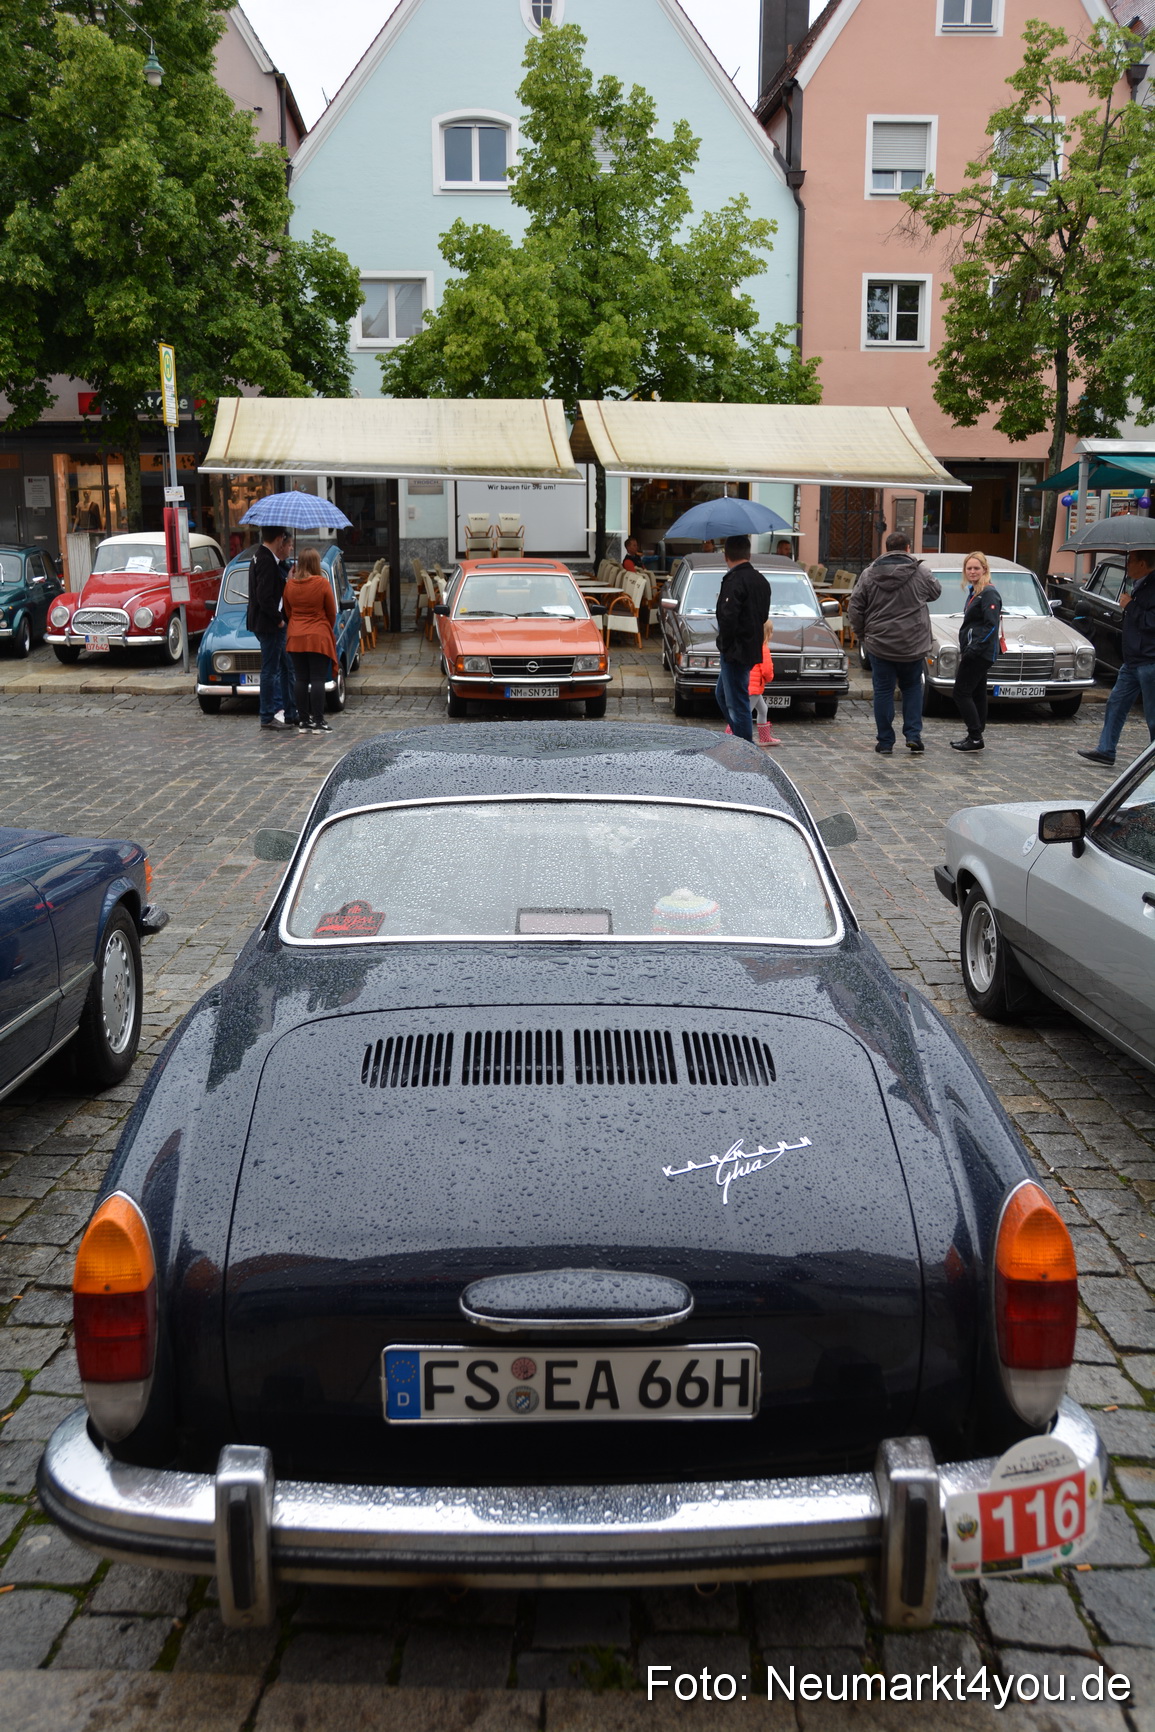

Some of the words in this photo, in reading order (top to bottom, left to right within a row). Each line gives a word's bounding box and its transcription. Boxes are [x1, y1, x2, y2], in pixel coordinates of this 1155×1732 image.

[246, 675, 253, 683] N
[510, 688, 522, 696] NM
[528, 688, 540, 696] SN
[541, 688, 559, 696] 91H
[999, 687, 1011, 696] NM
[1016, 687, 1027, 696] PG
[1028, 687, 1045, 696] 20H
[662, 1136, 812, 1176] KARMANN
[715, 1138, 785, 1205] Ghia
[423, 1359, 500, 1410] FS
[544, 1359, 620, 1410] EA
[638, 1358, 750, 1409] 66H
[397, 1391, 410, 1406] D
[991, 1480, 1080, 1554] 116
